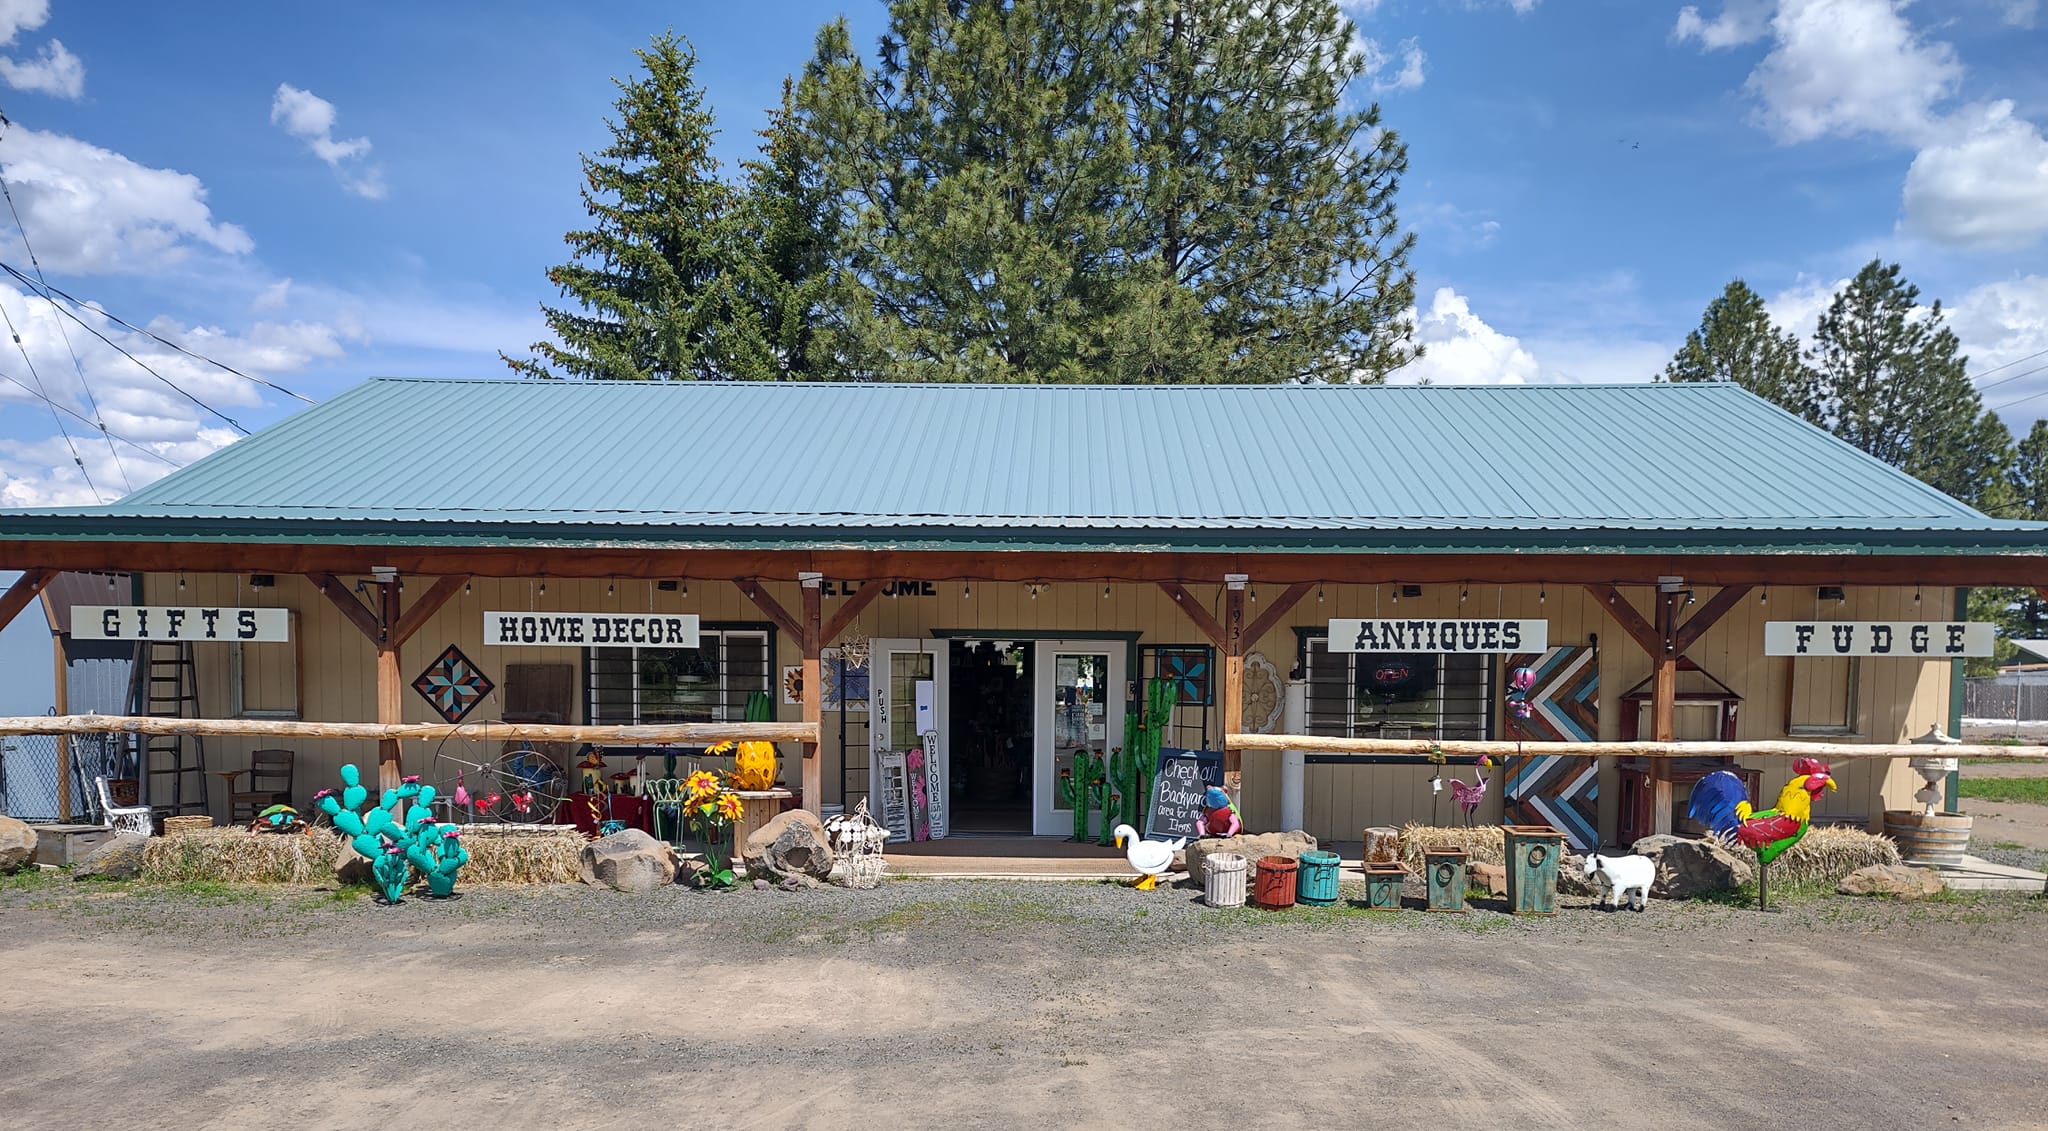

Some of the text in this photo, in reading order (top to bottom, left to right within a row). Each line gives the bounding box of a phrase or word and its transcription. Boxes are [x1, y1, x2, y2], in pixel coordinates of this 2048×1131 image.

[102, 608, 258, 639] GIFTS
[499, 616, 684, 644] HOME DECOR
[1354, 620, 1522, 651] ANTIQUES
[1795, 624, 1966, 654] FUDGE
[1375, 667, 1409, 680] OPEN
[877, 689, 887, 724] PUSH
[926, 735, 941, 802] WELCOME
[1164, 758, 1218, 782] Check out
[910, 772, 920, 820] WELCOME
[1157, 804, 1175, 817] area
[1177, 806, 1188, 819] for
[1168, 817, 1192, 833] Items
